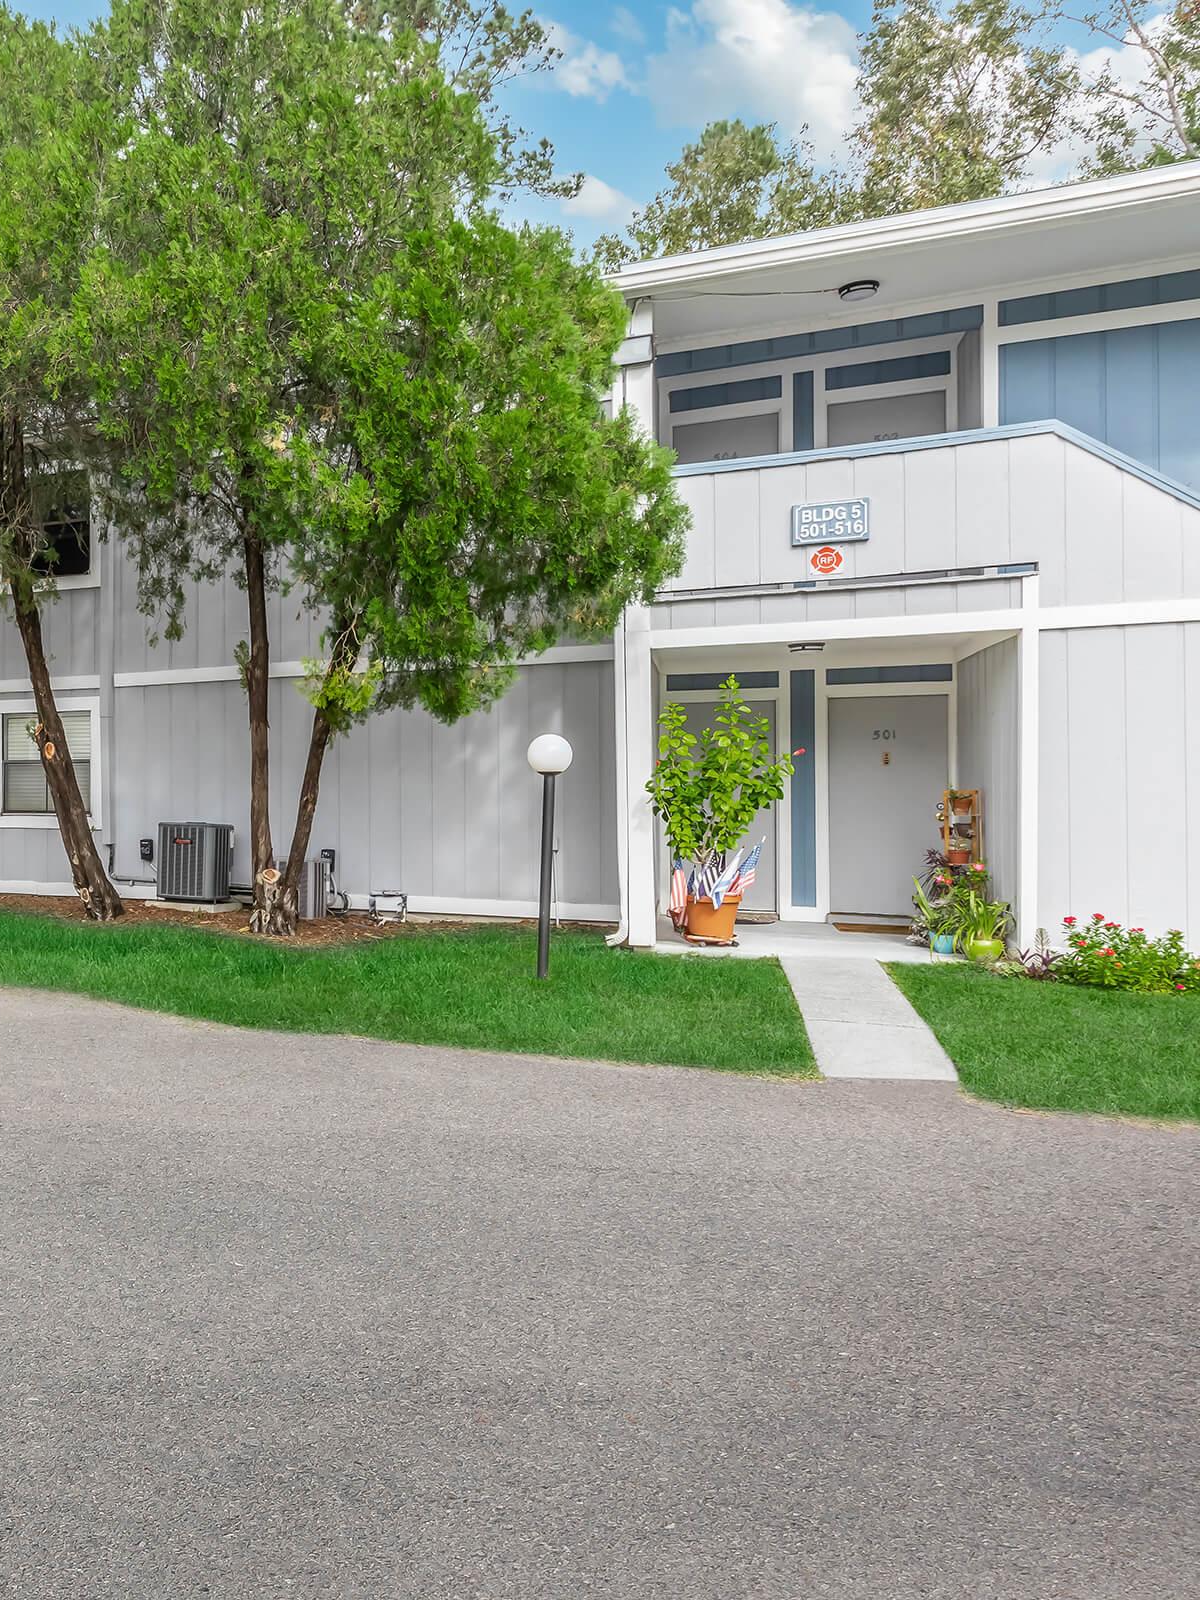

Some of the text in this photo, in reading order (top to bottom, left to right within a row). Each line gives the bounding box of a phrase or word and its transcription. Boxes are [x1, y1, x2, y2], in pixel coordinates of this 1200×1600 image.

[801, 505, 861, 523] BLDG 5
[800, 520, 863, 537] 501-516
[820, 556, 833, 564] RF
[872, 729, 896, 740] 501
